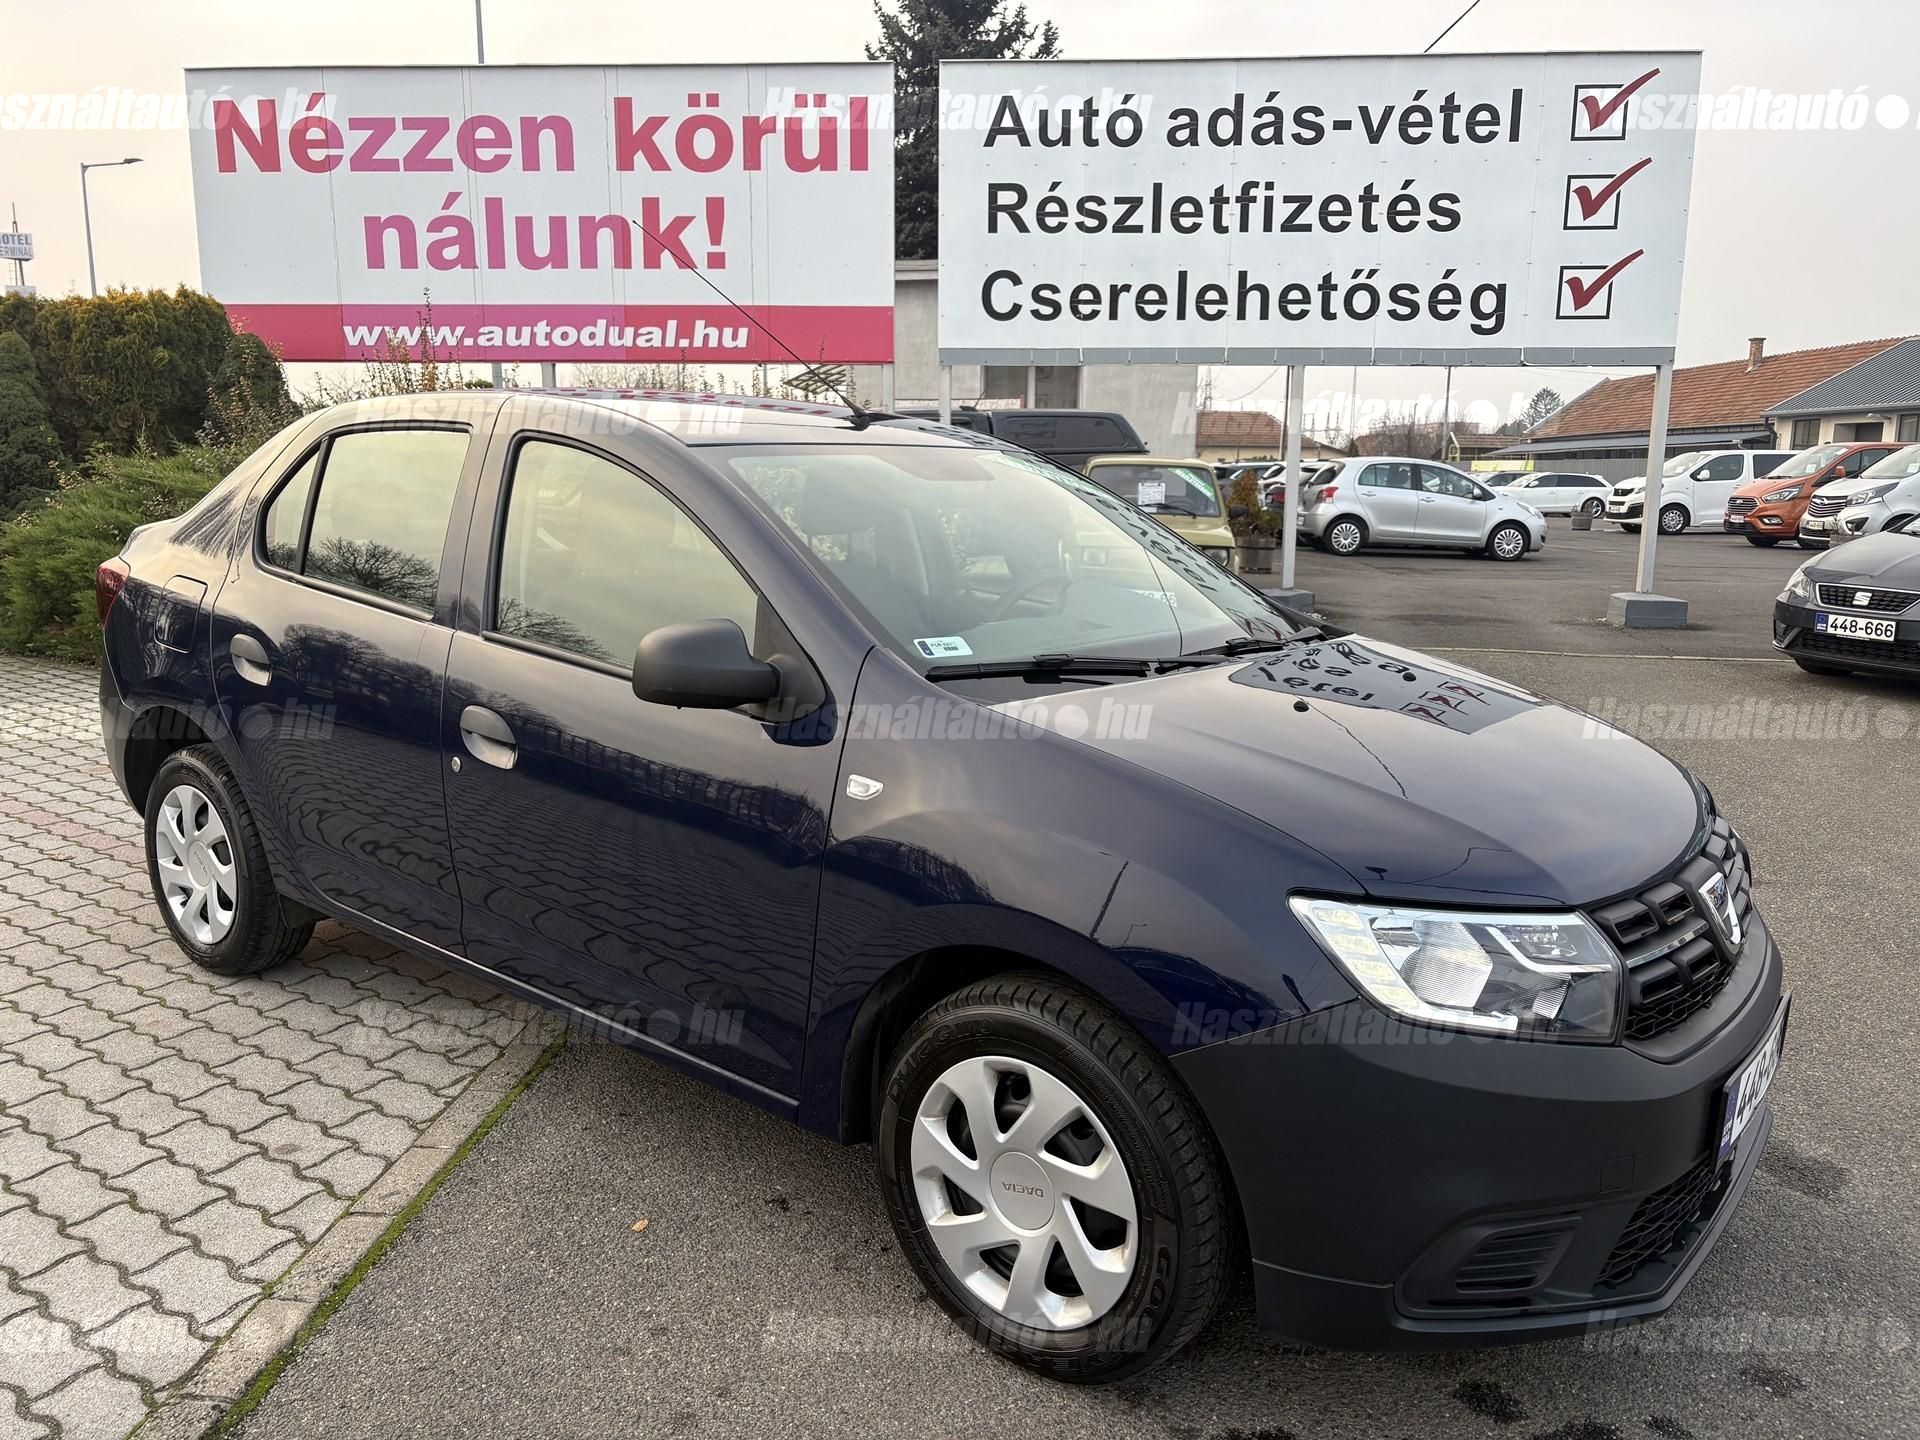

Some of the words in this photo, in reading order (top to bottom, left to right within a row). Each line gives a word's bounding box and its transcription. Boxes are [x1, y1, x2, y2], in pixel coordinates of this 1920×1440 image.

[212, 92, 575, 174] Nézzen
[613, 93, 869, 172] körül
[983, 93, 1143, 149] Autó
[1166, 88, 1522, 148] adás-vétel
[364, 191, 726, 270] nálunk!
[986, 178, 1462, 235] Részletfizetés
[0, 233, 32, 246] OTEL
[980, 268, 1507, 336] Cserelehetőség
[343, 319, 750, 349] www.autodual.hu
[1829, 617, 1894, 638] 448-666
[1002, 1181, 1044, 1198] DACIA
